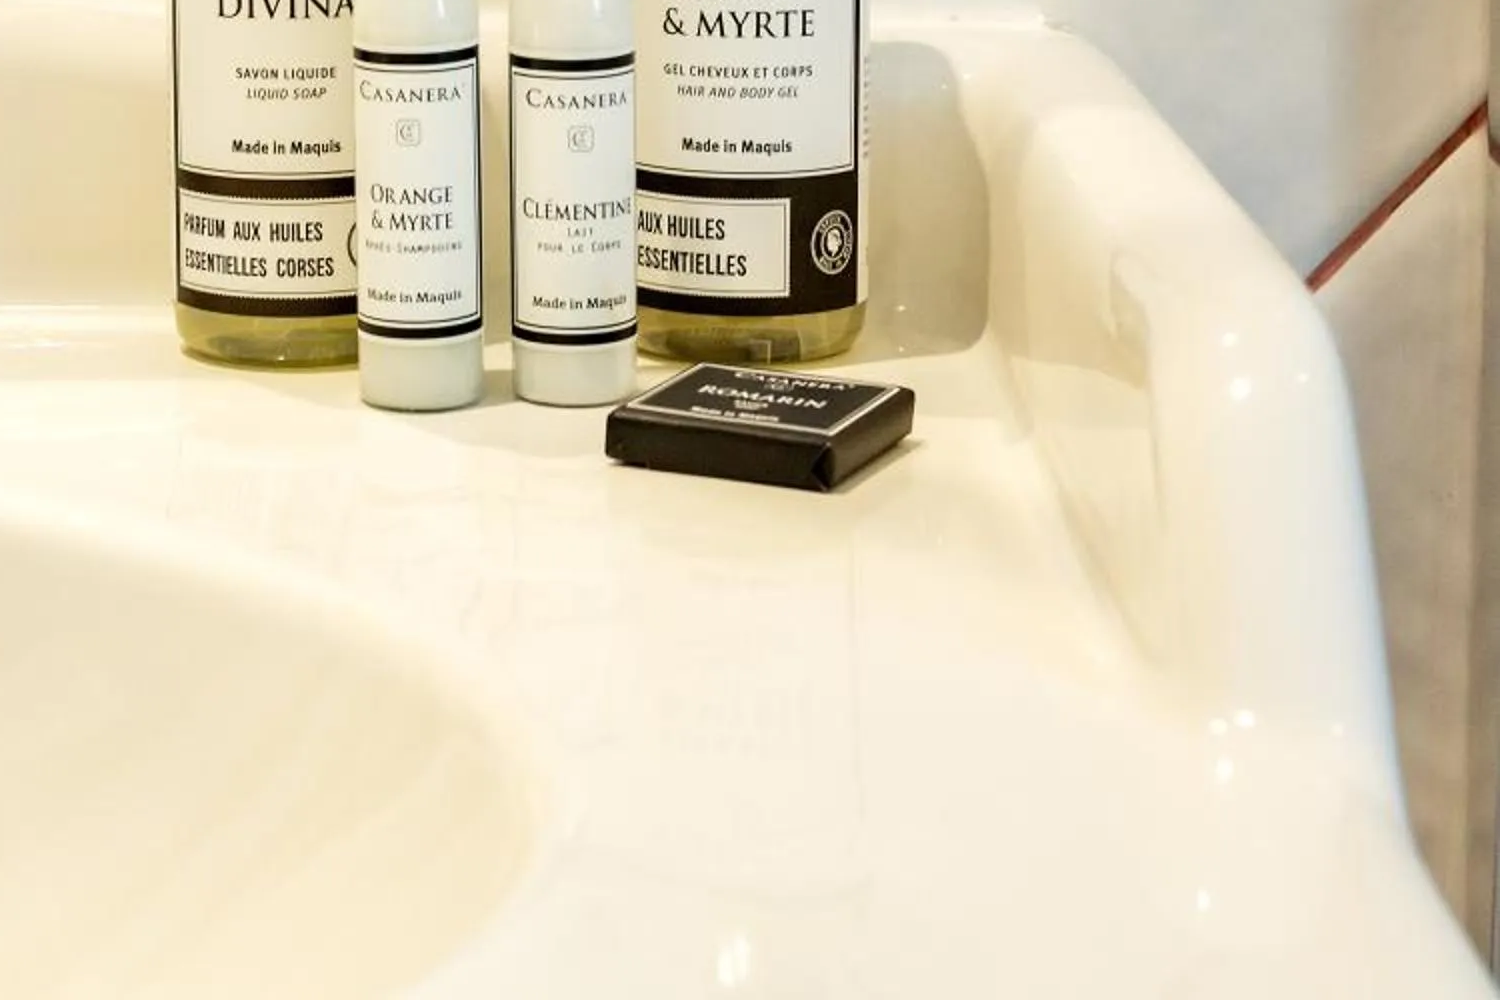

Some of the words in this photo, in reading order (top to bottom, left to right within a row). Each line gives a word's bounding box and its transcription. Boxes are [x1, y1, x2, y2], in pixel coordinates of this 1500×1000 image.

[663, 7, 687, 36] &
[696, 9, 815, 38] MYRTE
[235, 67, 279, 80] SAVON
[284, 66, 337, 81] LIQUIDE
[663, 63, 685, 76] GEL
[689, 66, 749, 79] CHEVEUX
[753, 66, 768, 79] ET
[773, 65, 813, 78] CORPS
[246, 87, 287, 100] LIQUID
[293, 87, 327, 100] SOAP
[677, 85, 705, 97] HAIR
[709, 86, 736, 99] AND
[739, 87, 774, 99] BODY
[777, 86, 799, 98] GEL
[231, 139, 269, 154] Made
[273, 140, 285, 154] in
[290, 139, 341, 157] Maquis
[681, 137, 719, 153] Made
[723, 139, 737, 153] in
[741, 139, 793, 156] Maquis
[371, 183, 453, 205] ORANGE
[184, 212, 225, 238] PARFUM
[233, 221, 261, 241] AUX
[269, 222, 323, 242] HUILES
[372, 209, 384, 229] &
[389, 212, 453, 231] MYRTE
[637, 209, 663, 235] AUX
[667, 217, 725, 241] HUILES
[185, 247, 267, 277] ESSENTIELLES
[276, 257, 334, 278] CORSES
[637, 245, 748, 277] ESSENTIELLES
[367, 287, 397, 302] Made
[400, 290, 413, 303] in
[415, 289, 462, 305] Maquis
[532, 296, 567, 309] Made
[570, 297, 583, 310] in
[698, 384, 828, 409] ROMARIN
